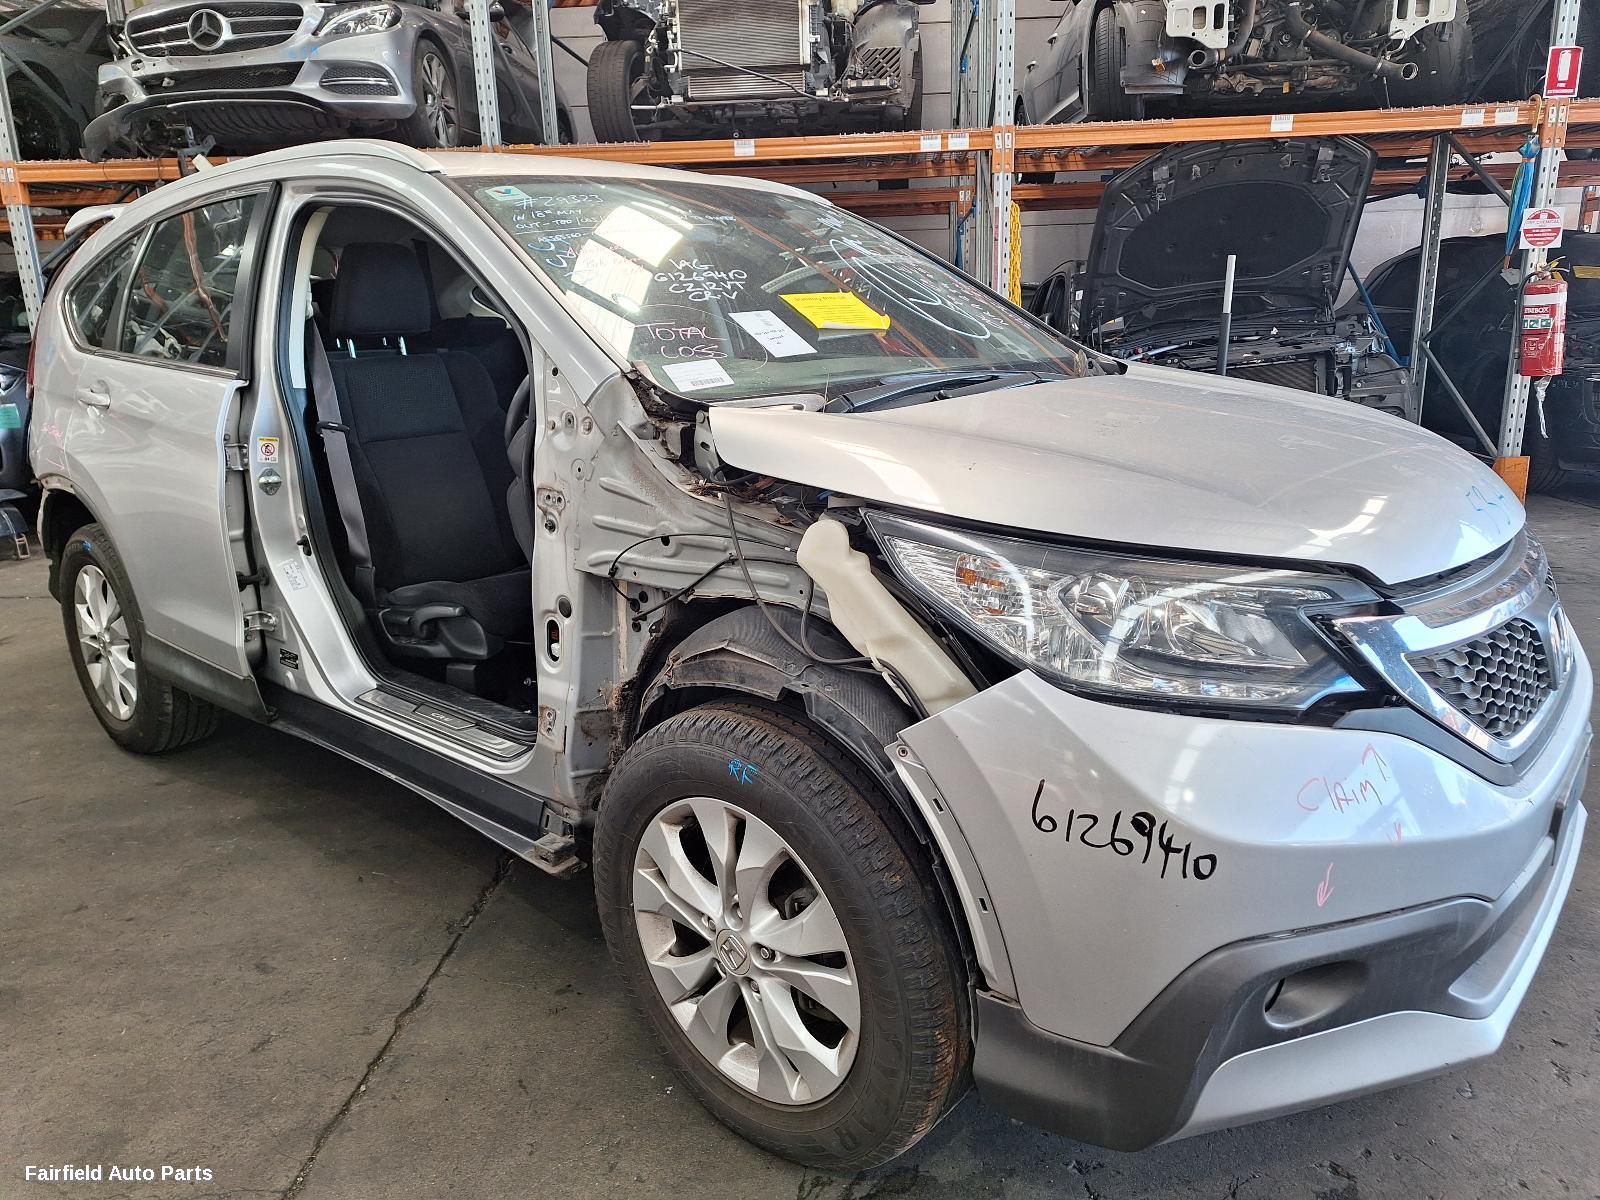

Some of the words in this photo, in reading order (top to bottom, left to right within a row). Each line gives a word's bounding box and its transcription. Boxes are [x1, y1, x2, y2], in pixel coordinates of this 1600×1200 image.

[635, 321, 728, 341] TOTAL
[660, 344, 728, 359] LOSS
[1031, 779, 1218, 881] 61269410
